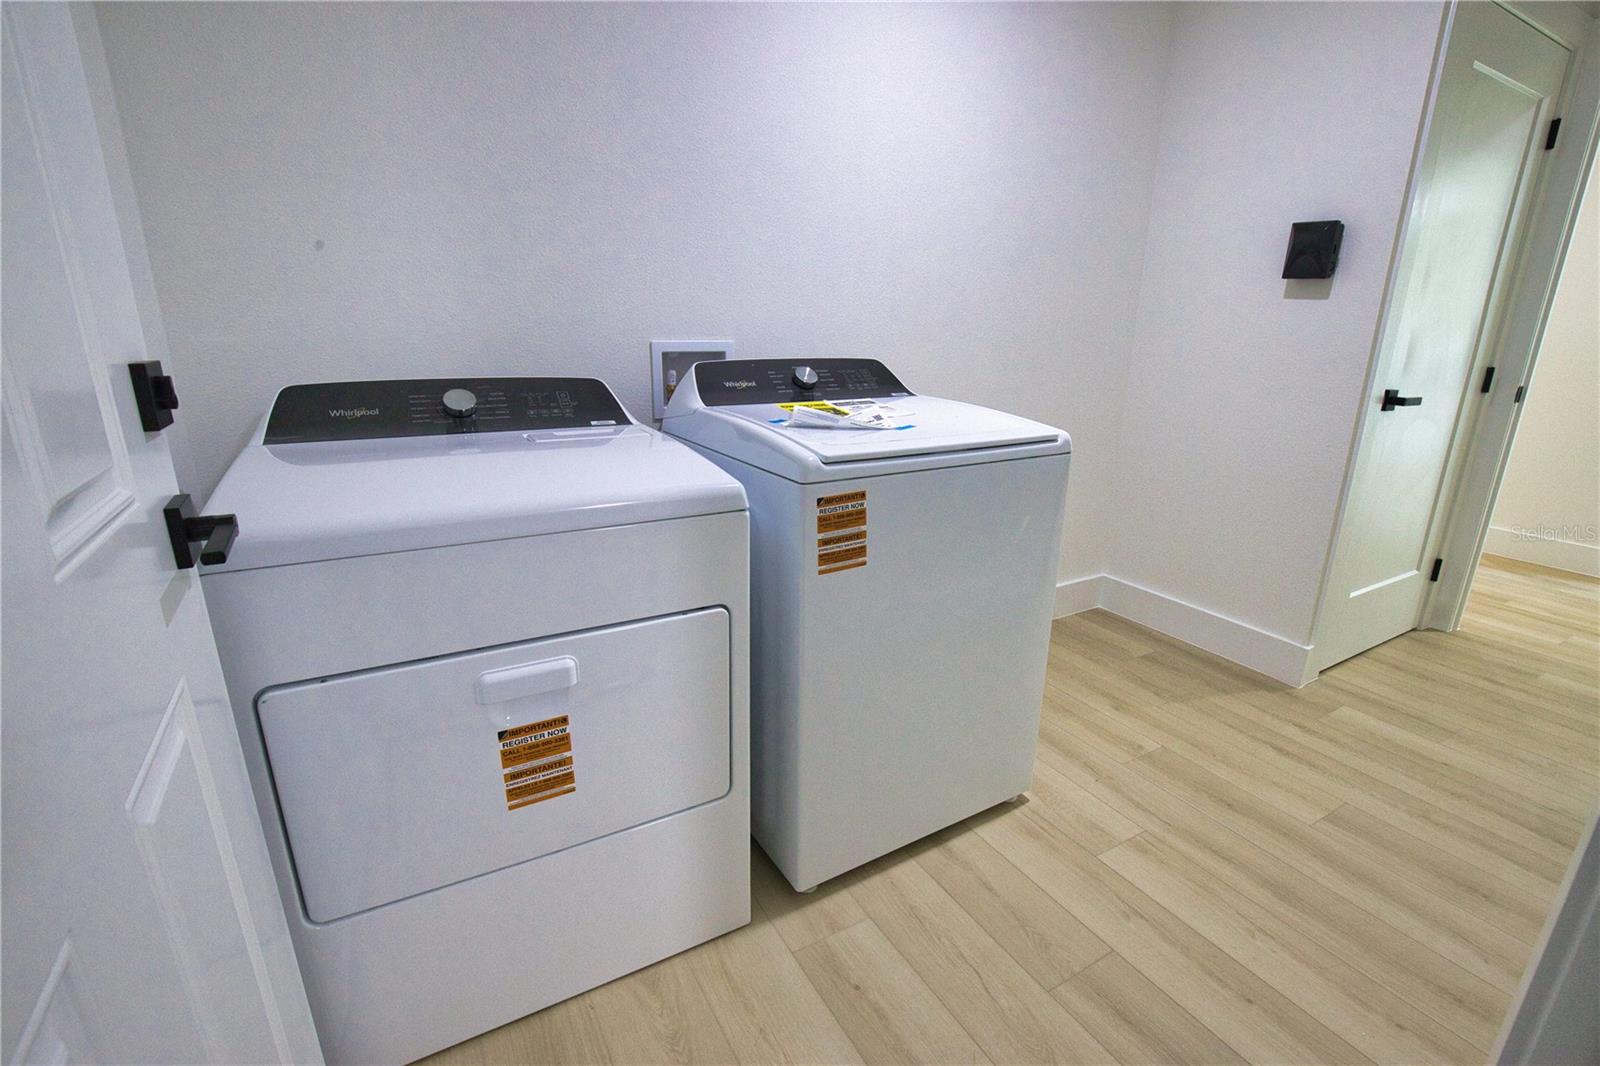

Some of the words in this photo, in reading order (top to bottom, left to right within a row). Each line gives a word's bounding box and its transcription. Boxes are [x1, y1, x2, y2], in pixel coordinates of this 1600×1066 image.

[722, 380, 756, 389] Whirlpool
[328, 407, 379, 418] Whirlpool
[819, 505, 850, 514] REGISTER
[502, 733, 546, 748] REGISTER
[547, 727, 567, 737] NOW
[503, 748, 520, 757] CALL
